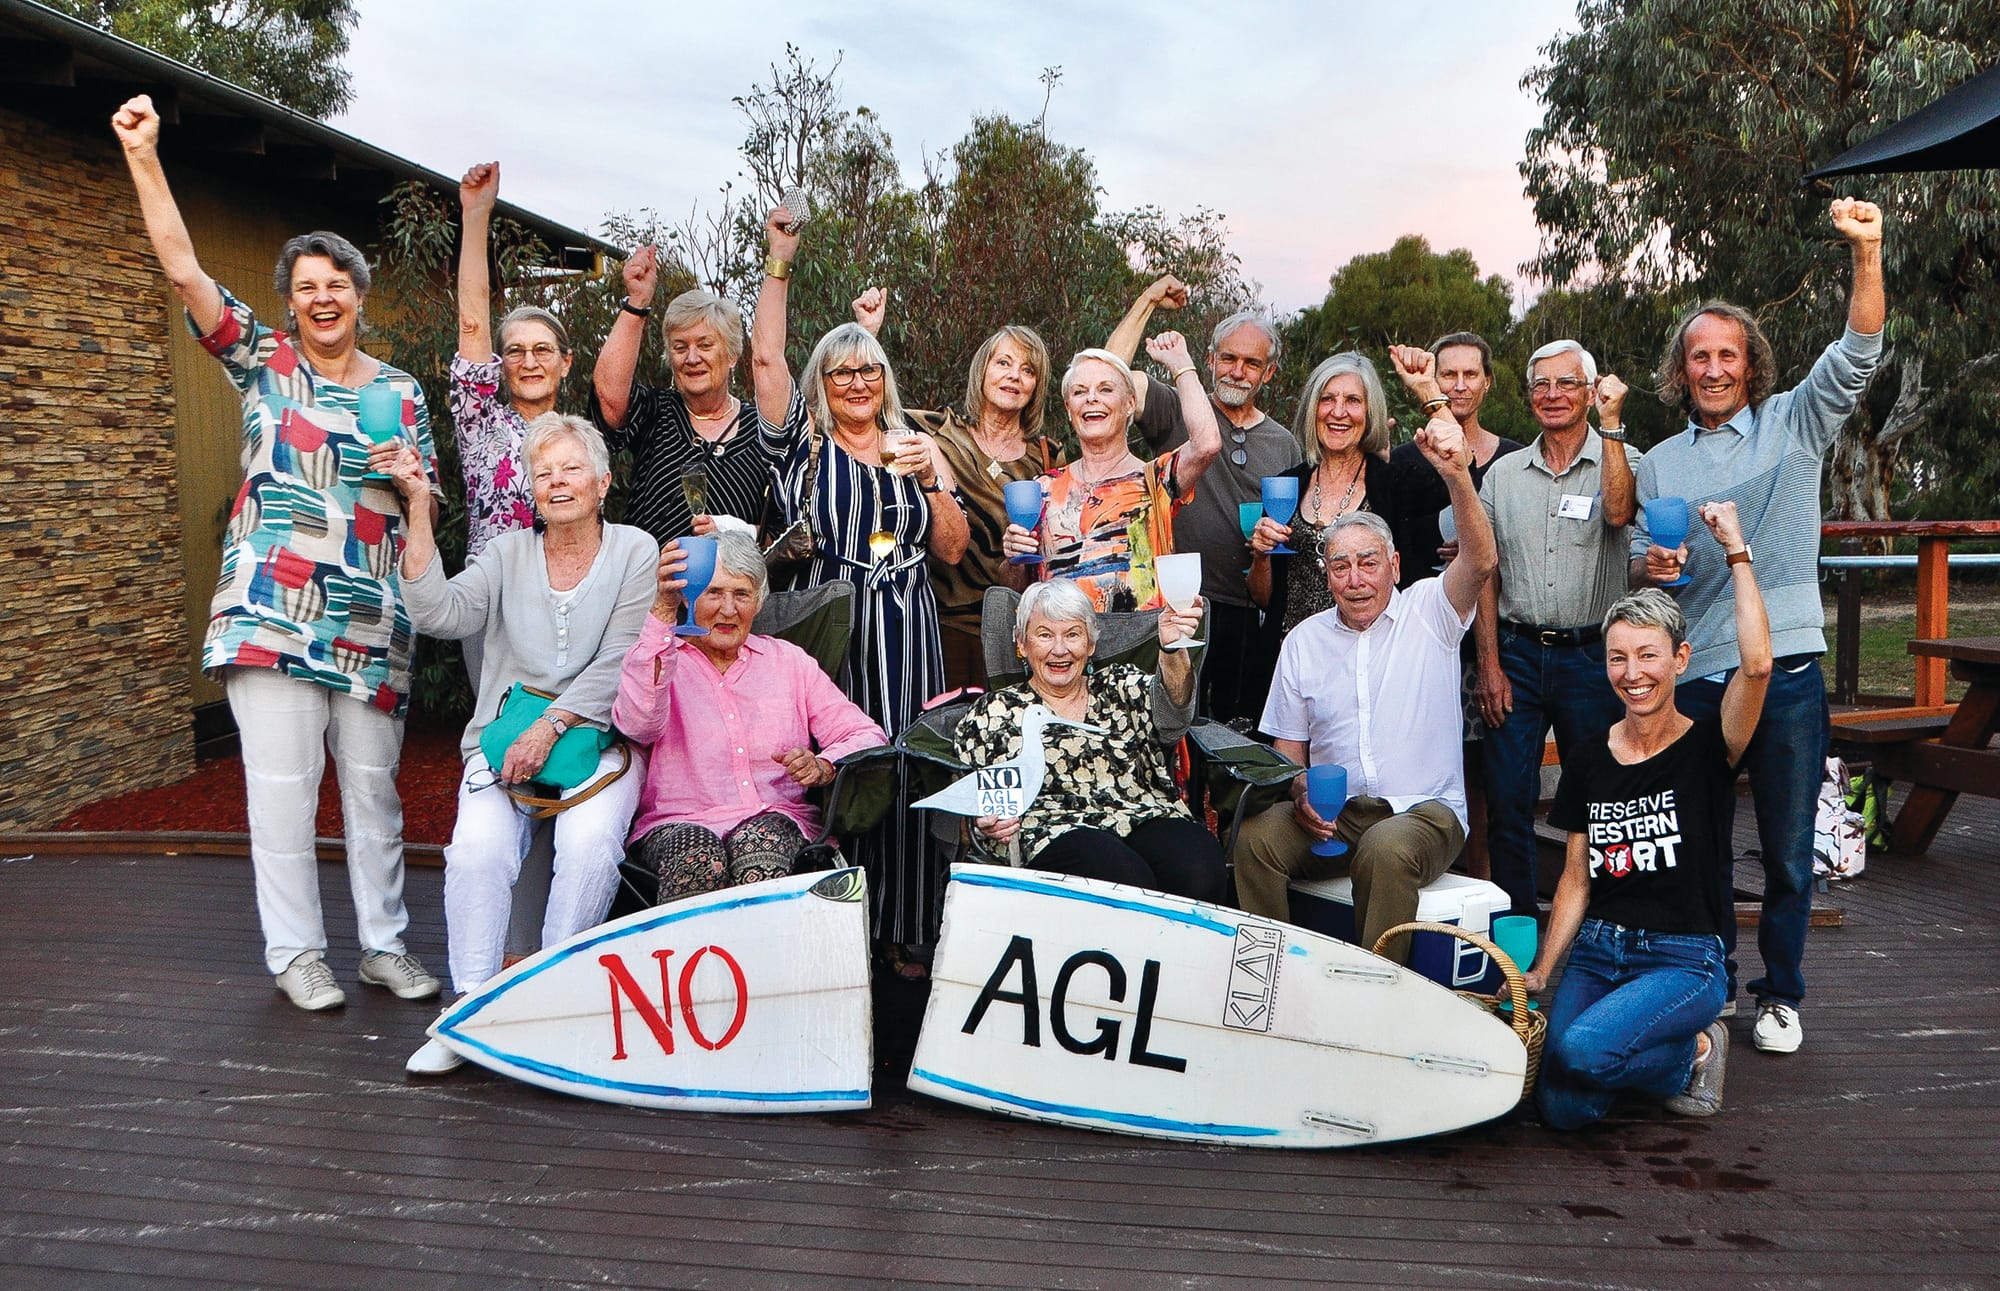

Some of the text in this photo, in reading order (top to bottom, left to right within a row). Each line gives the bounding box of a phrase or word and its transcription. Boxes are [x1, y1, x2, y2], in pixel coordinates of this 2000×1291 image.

[979, 768, 1020, 790] NO
[981, 790, 1018, 805] AGL
[983, 804, 1018, 817] gas
[1587, 789, 1676, 820] RESERVE
[598, 944, 748, 1061] NO
[961, 934, 1188, 1074] AGL
